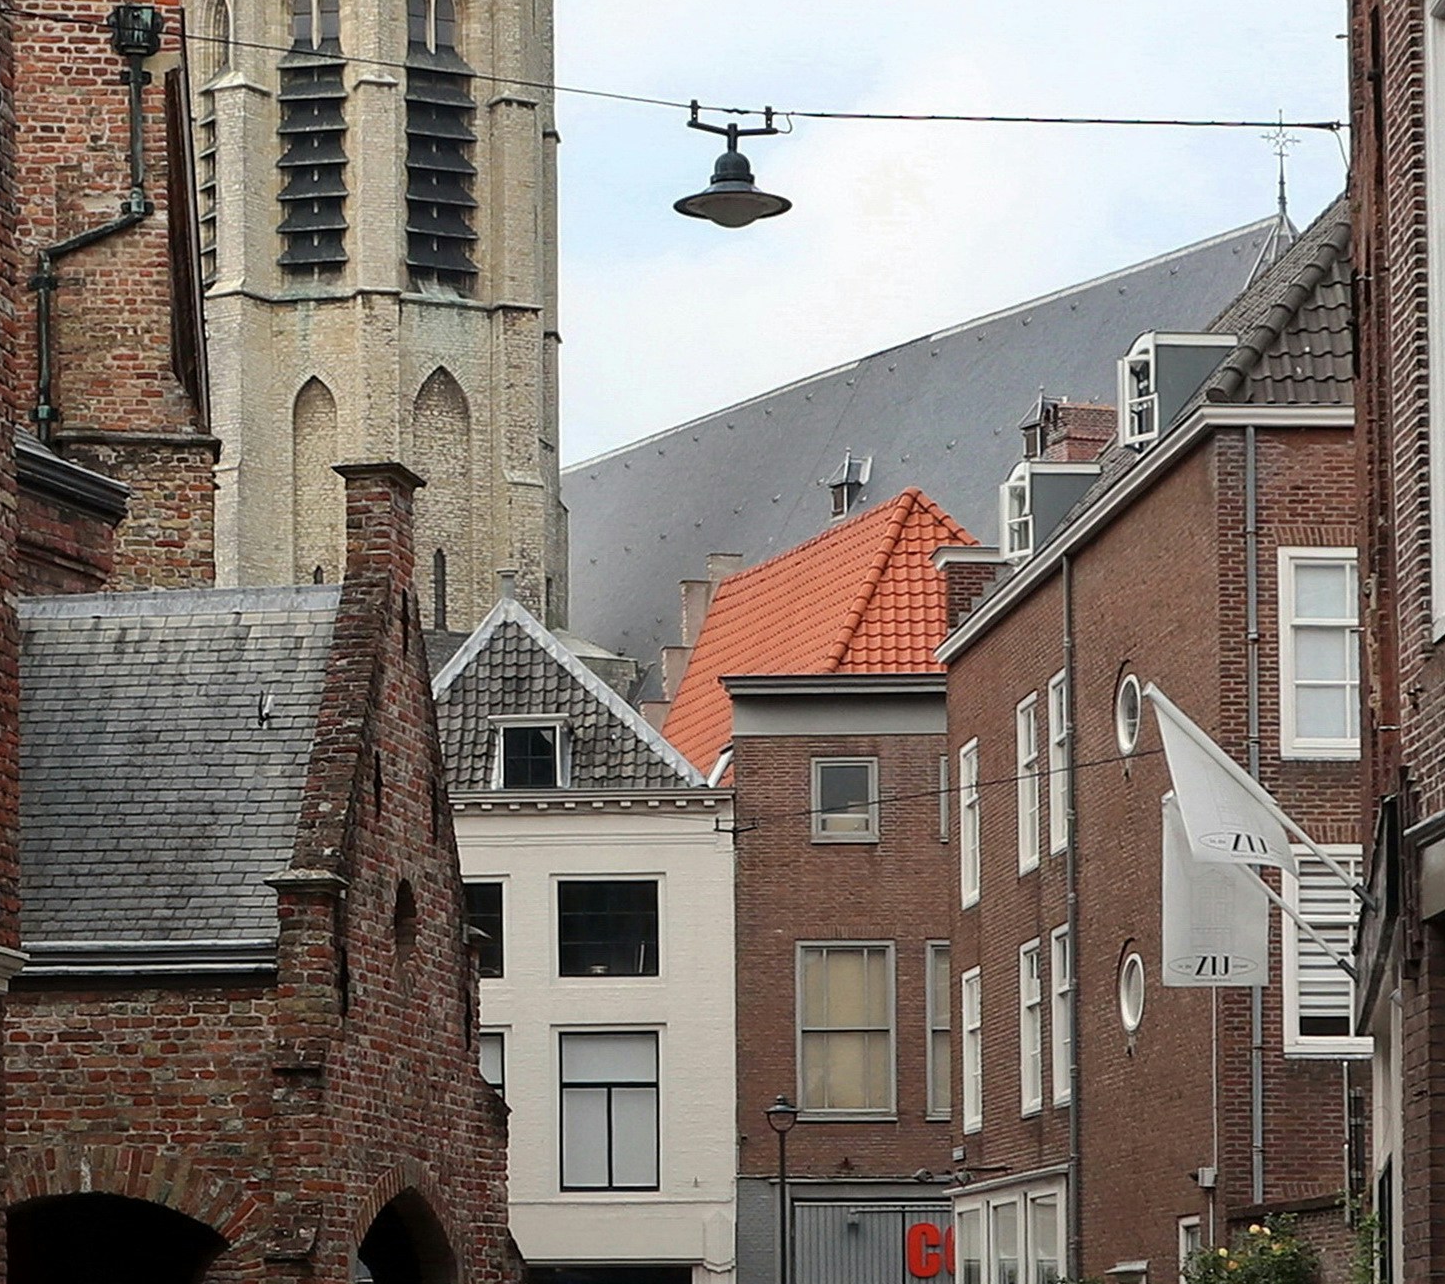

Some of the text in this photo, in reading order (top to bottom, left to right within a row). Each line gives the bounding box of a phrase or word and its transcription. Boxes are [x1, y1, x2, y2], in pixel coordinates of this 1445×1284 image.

[1227, 832, 1268, 854] ZIJ
[1194, 955, 1230, 976] ZIJ
[907, 1222, 955, 1279] C
